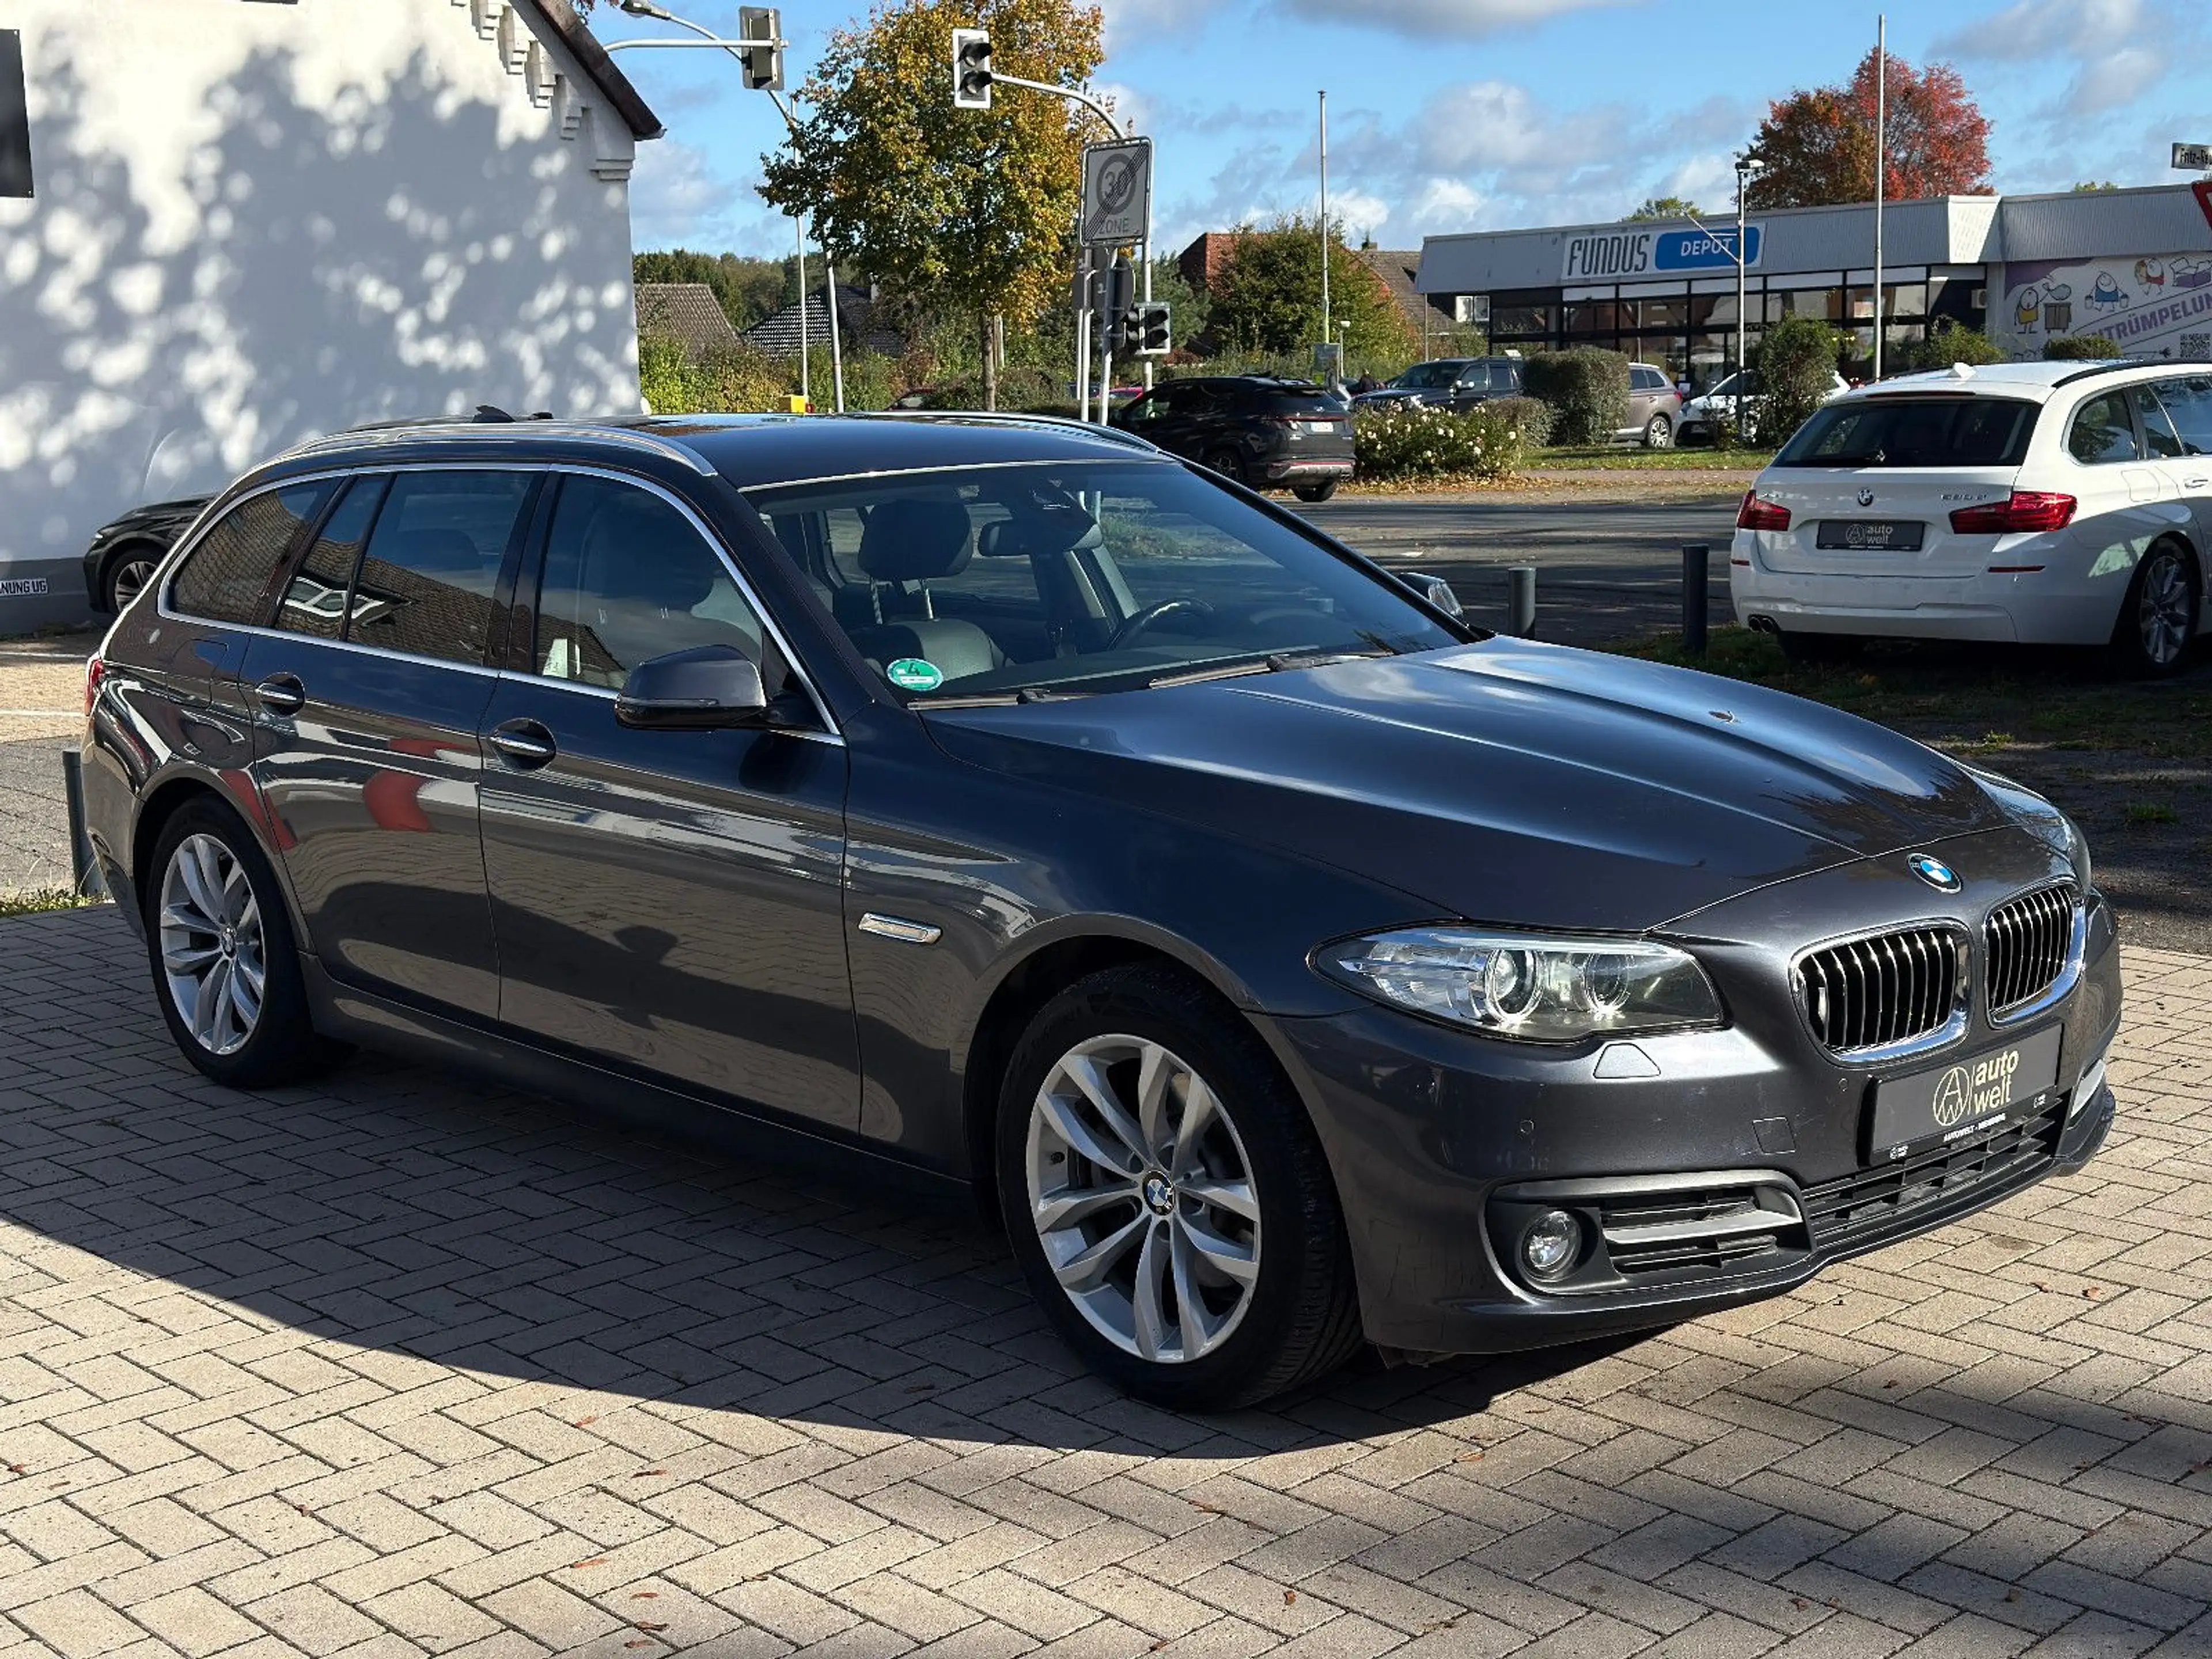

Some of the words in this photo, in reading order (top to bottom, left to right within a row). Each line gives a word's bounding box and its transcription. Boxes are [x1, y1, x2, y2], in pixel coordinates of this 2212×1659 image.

[1099, 218, 1130, 234] ZONE
[1567, 234, 1650, 276] FUNDUS
[1680, 238, 1733, 257] DEPOT
[1866, 525, 1893, 535] auto
[1866, 535, 1890, 544] welt
[0, 581, 30, 594] NUNG
[32, 580, 46, 592] UG
[1975, 1050, 2019, 1086] auto
[1974, 1074, 2012, 1115] welt
